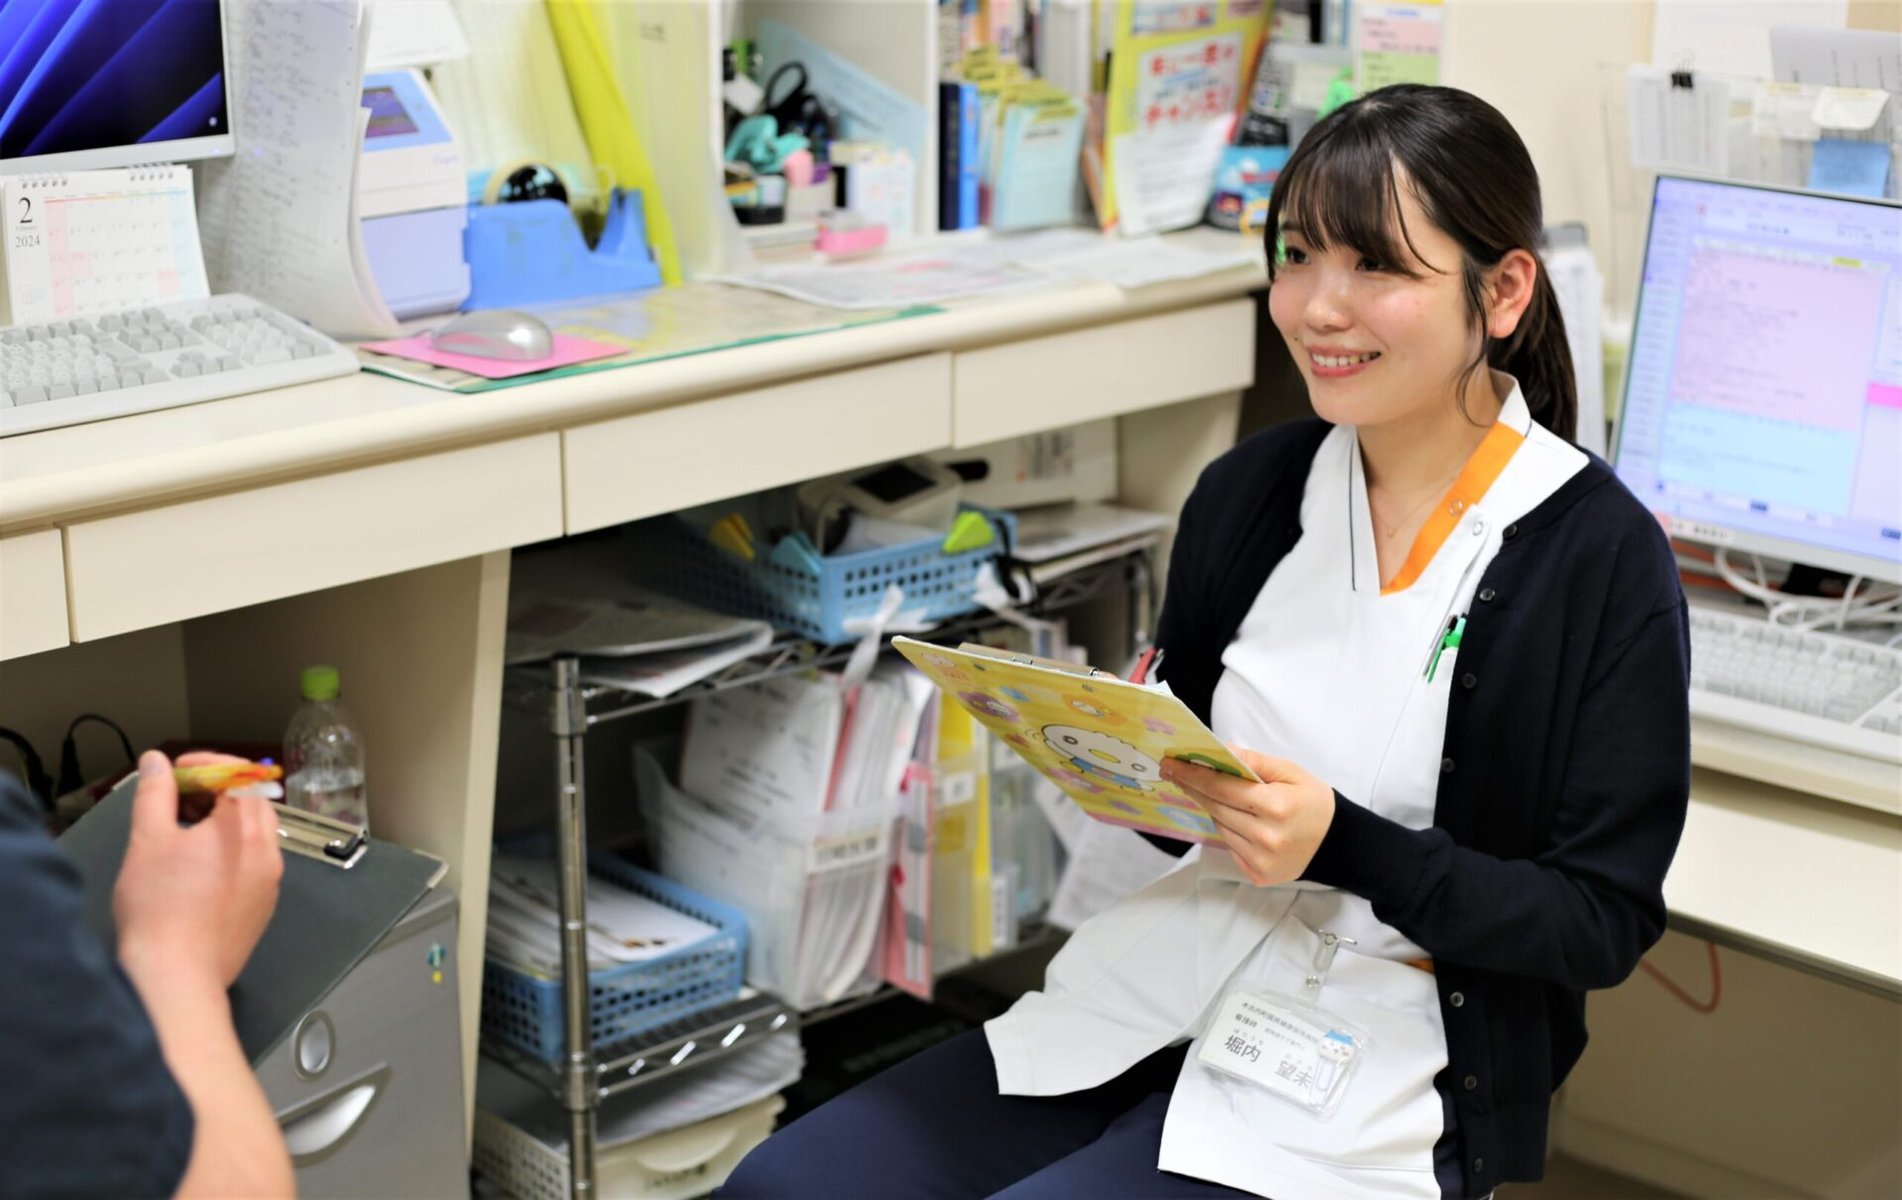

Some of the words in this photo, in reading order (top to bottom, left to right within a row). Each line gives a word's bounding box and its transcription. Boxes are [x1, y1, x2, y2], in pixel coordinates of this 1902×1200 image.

[18, 197, 33, 224] 2
[15, 234, 40, 248] 2024
[1224, 1034, 1261, 1063] 堀内
[1273, 1060, 1313, 1090] 望未
